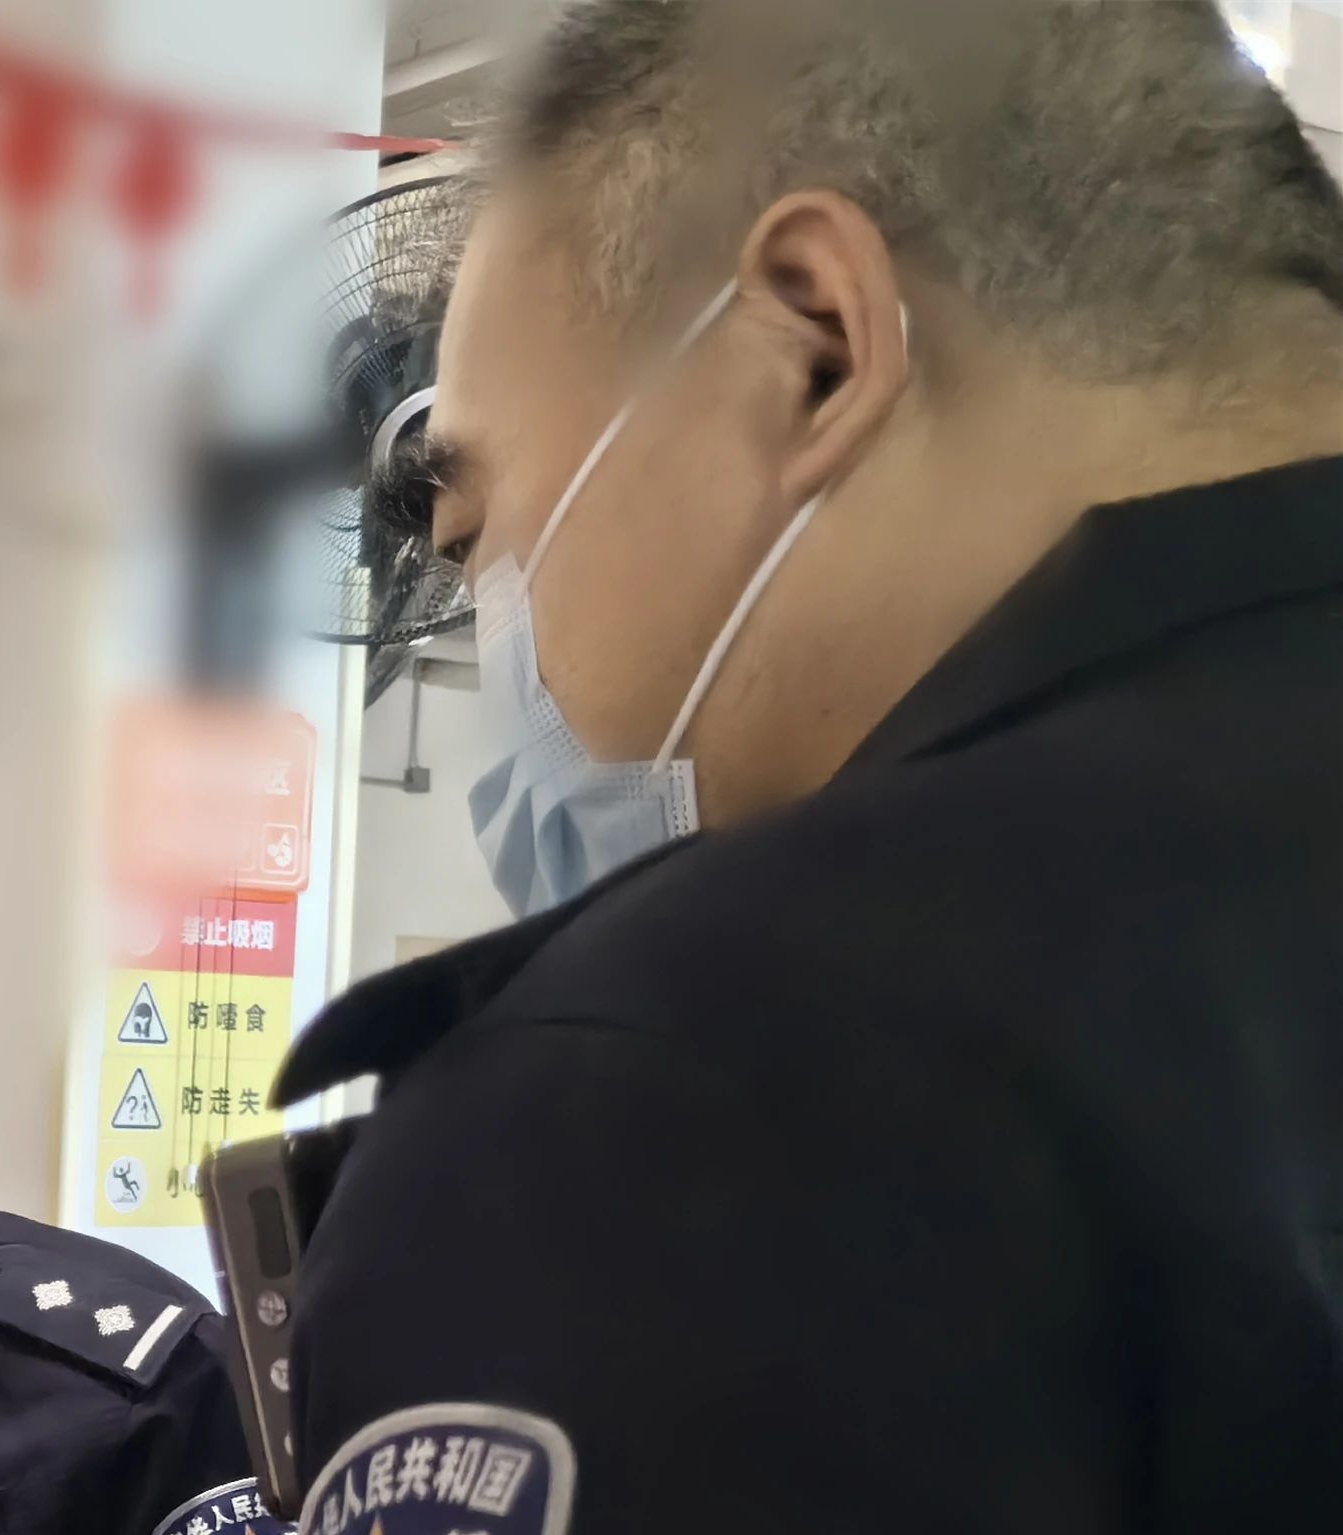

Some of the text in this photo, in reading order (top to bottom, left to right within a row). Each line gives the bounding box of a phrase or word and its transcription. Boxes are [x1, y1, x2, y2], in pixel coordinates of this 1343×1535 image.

[181, 914, 275, 952] 禁止吸烟
[187, 1001, 266, 1032] 防噎食
[181, 1085, 260, 1116] 防走失
